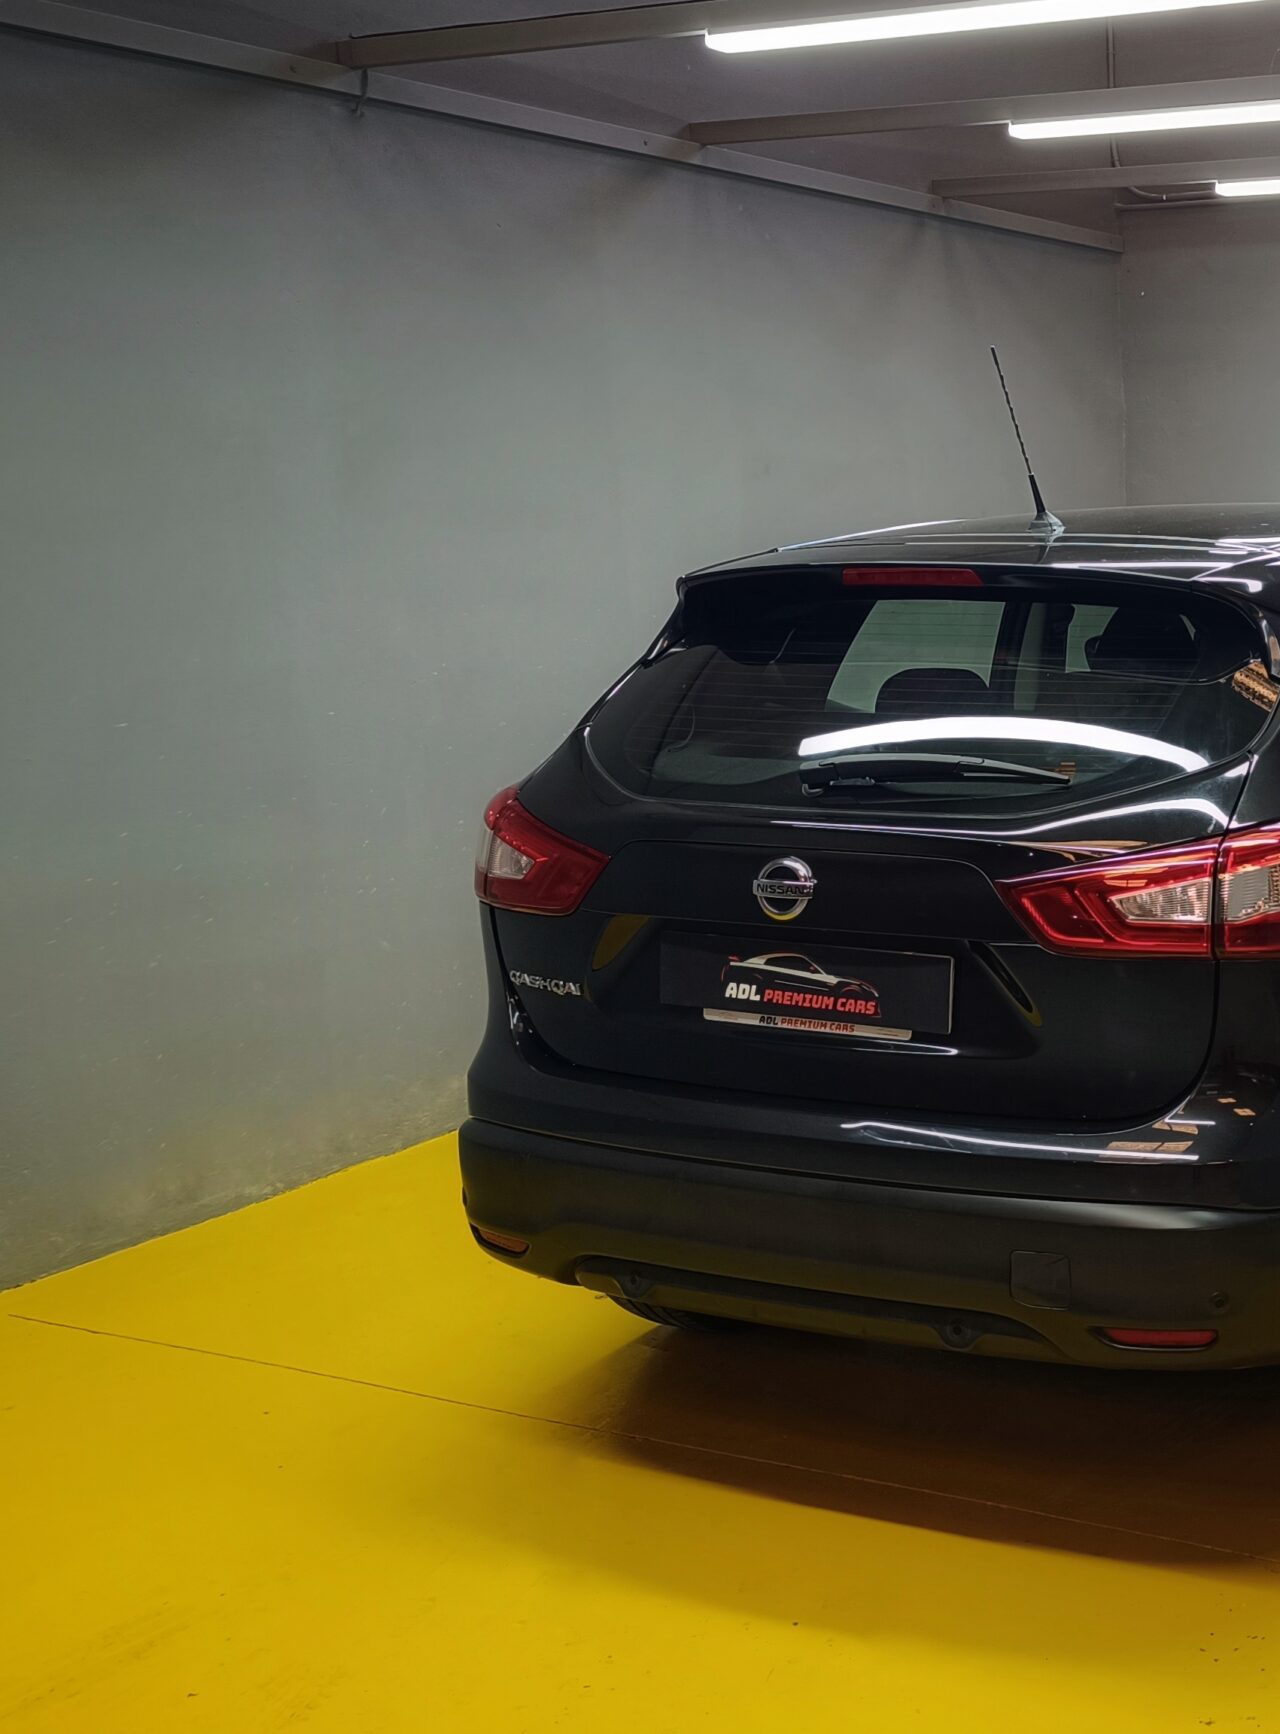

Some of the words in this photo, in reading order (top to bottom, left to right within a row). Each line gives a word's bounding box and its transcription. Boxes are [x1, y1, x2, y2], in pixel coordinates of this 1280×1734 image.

[756, 883, 804, 895] NISSAN
[509, 970, 582, 996] QASHQAI
[725, 982, 760, 1002] ADL
[764, 988, 835, 1010] PREMIUM
[836, 998, 876, 1015] CARS
[758, 1015, 779, 1026] ADL
[780, 1018, 828, 1031] PREMIUM
[829, 1022, 855, 1034] CARS
